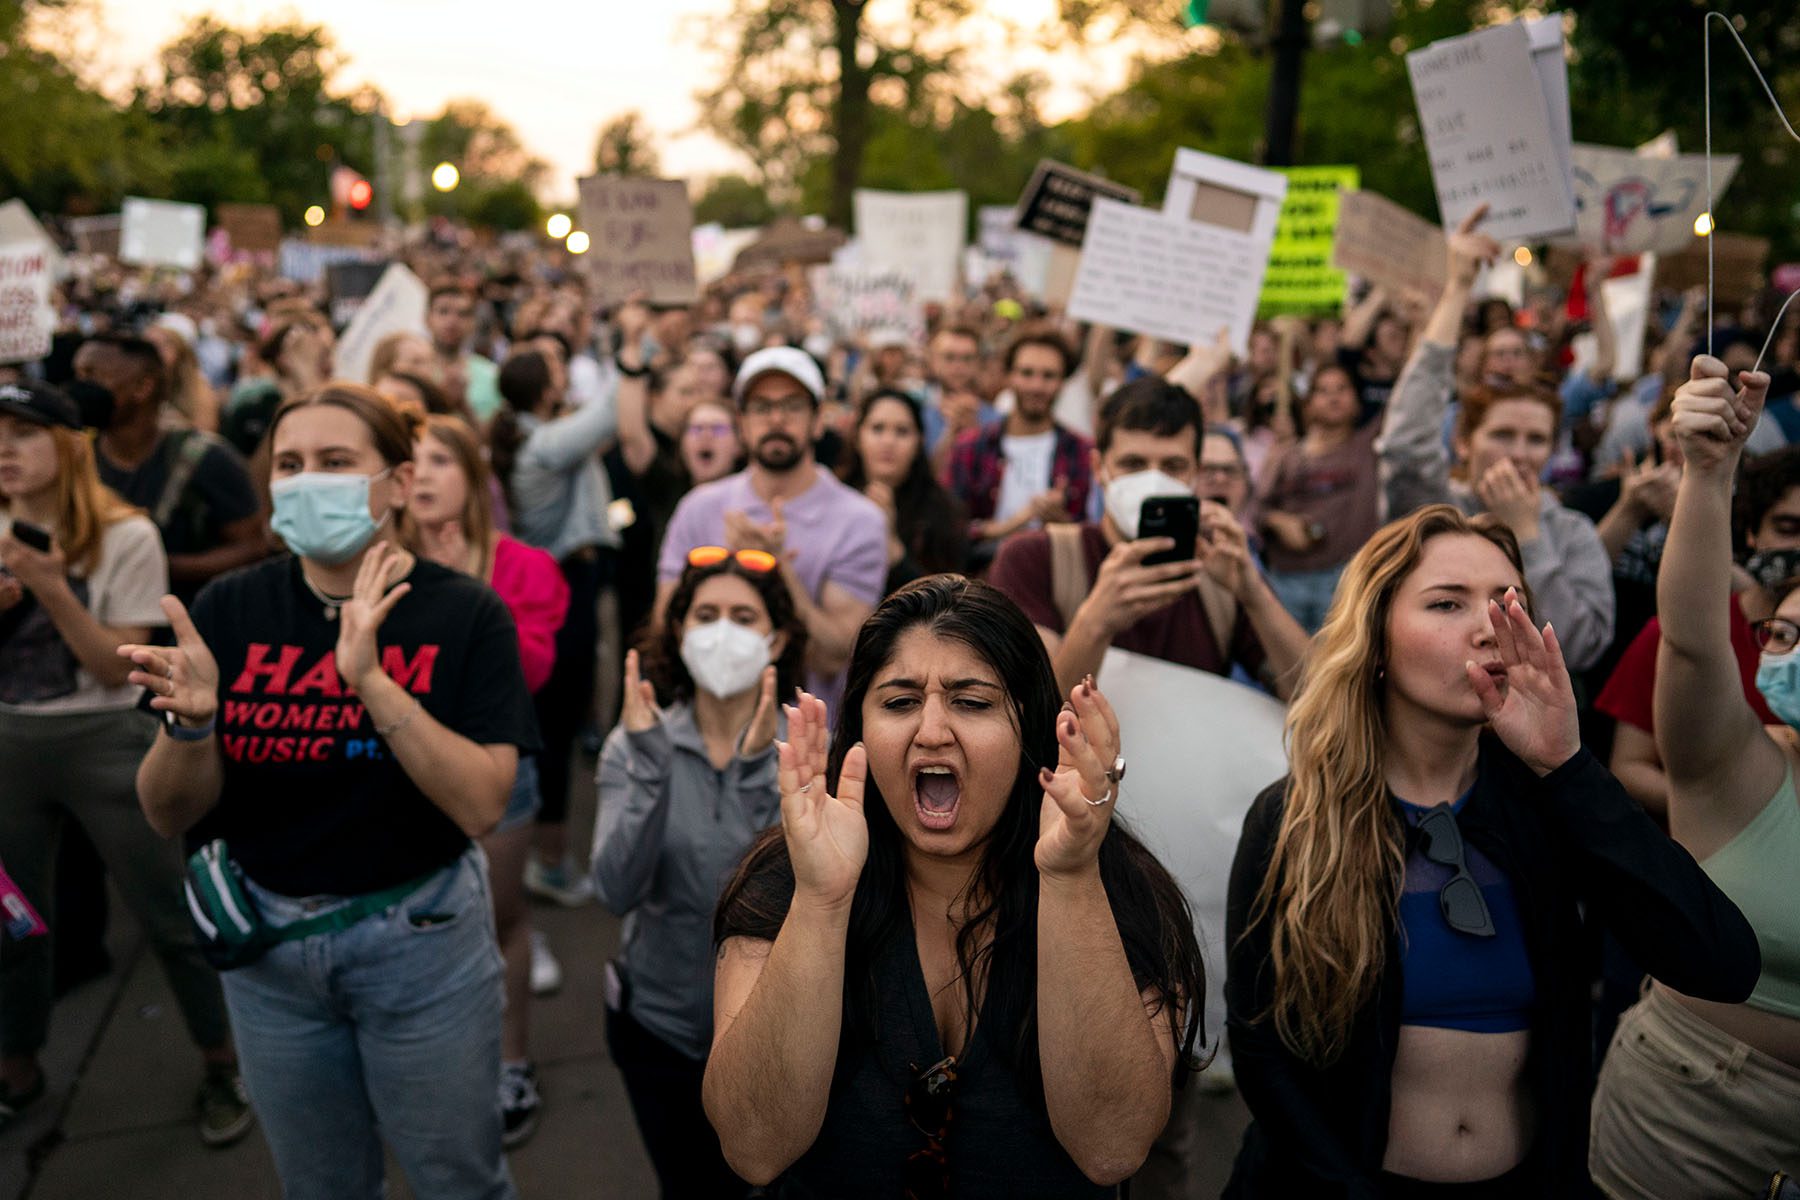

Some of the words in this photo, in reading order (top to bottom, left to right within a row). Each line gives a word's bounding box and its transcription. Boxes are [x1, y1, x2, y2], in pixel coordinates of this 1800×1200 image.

[230, 643, 440, 697] HAM
[224, 700, 365, 731] WOMEN
[223, 734, 335, 763] MUSIC
